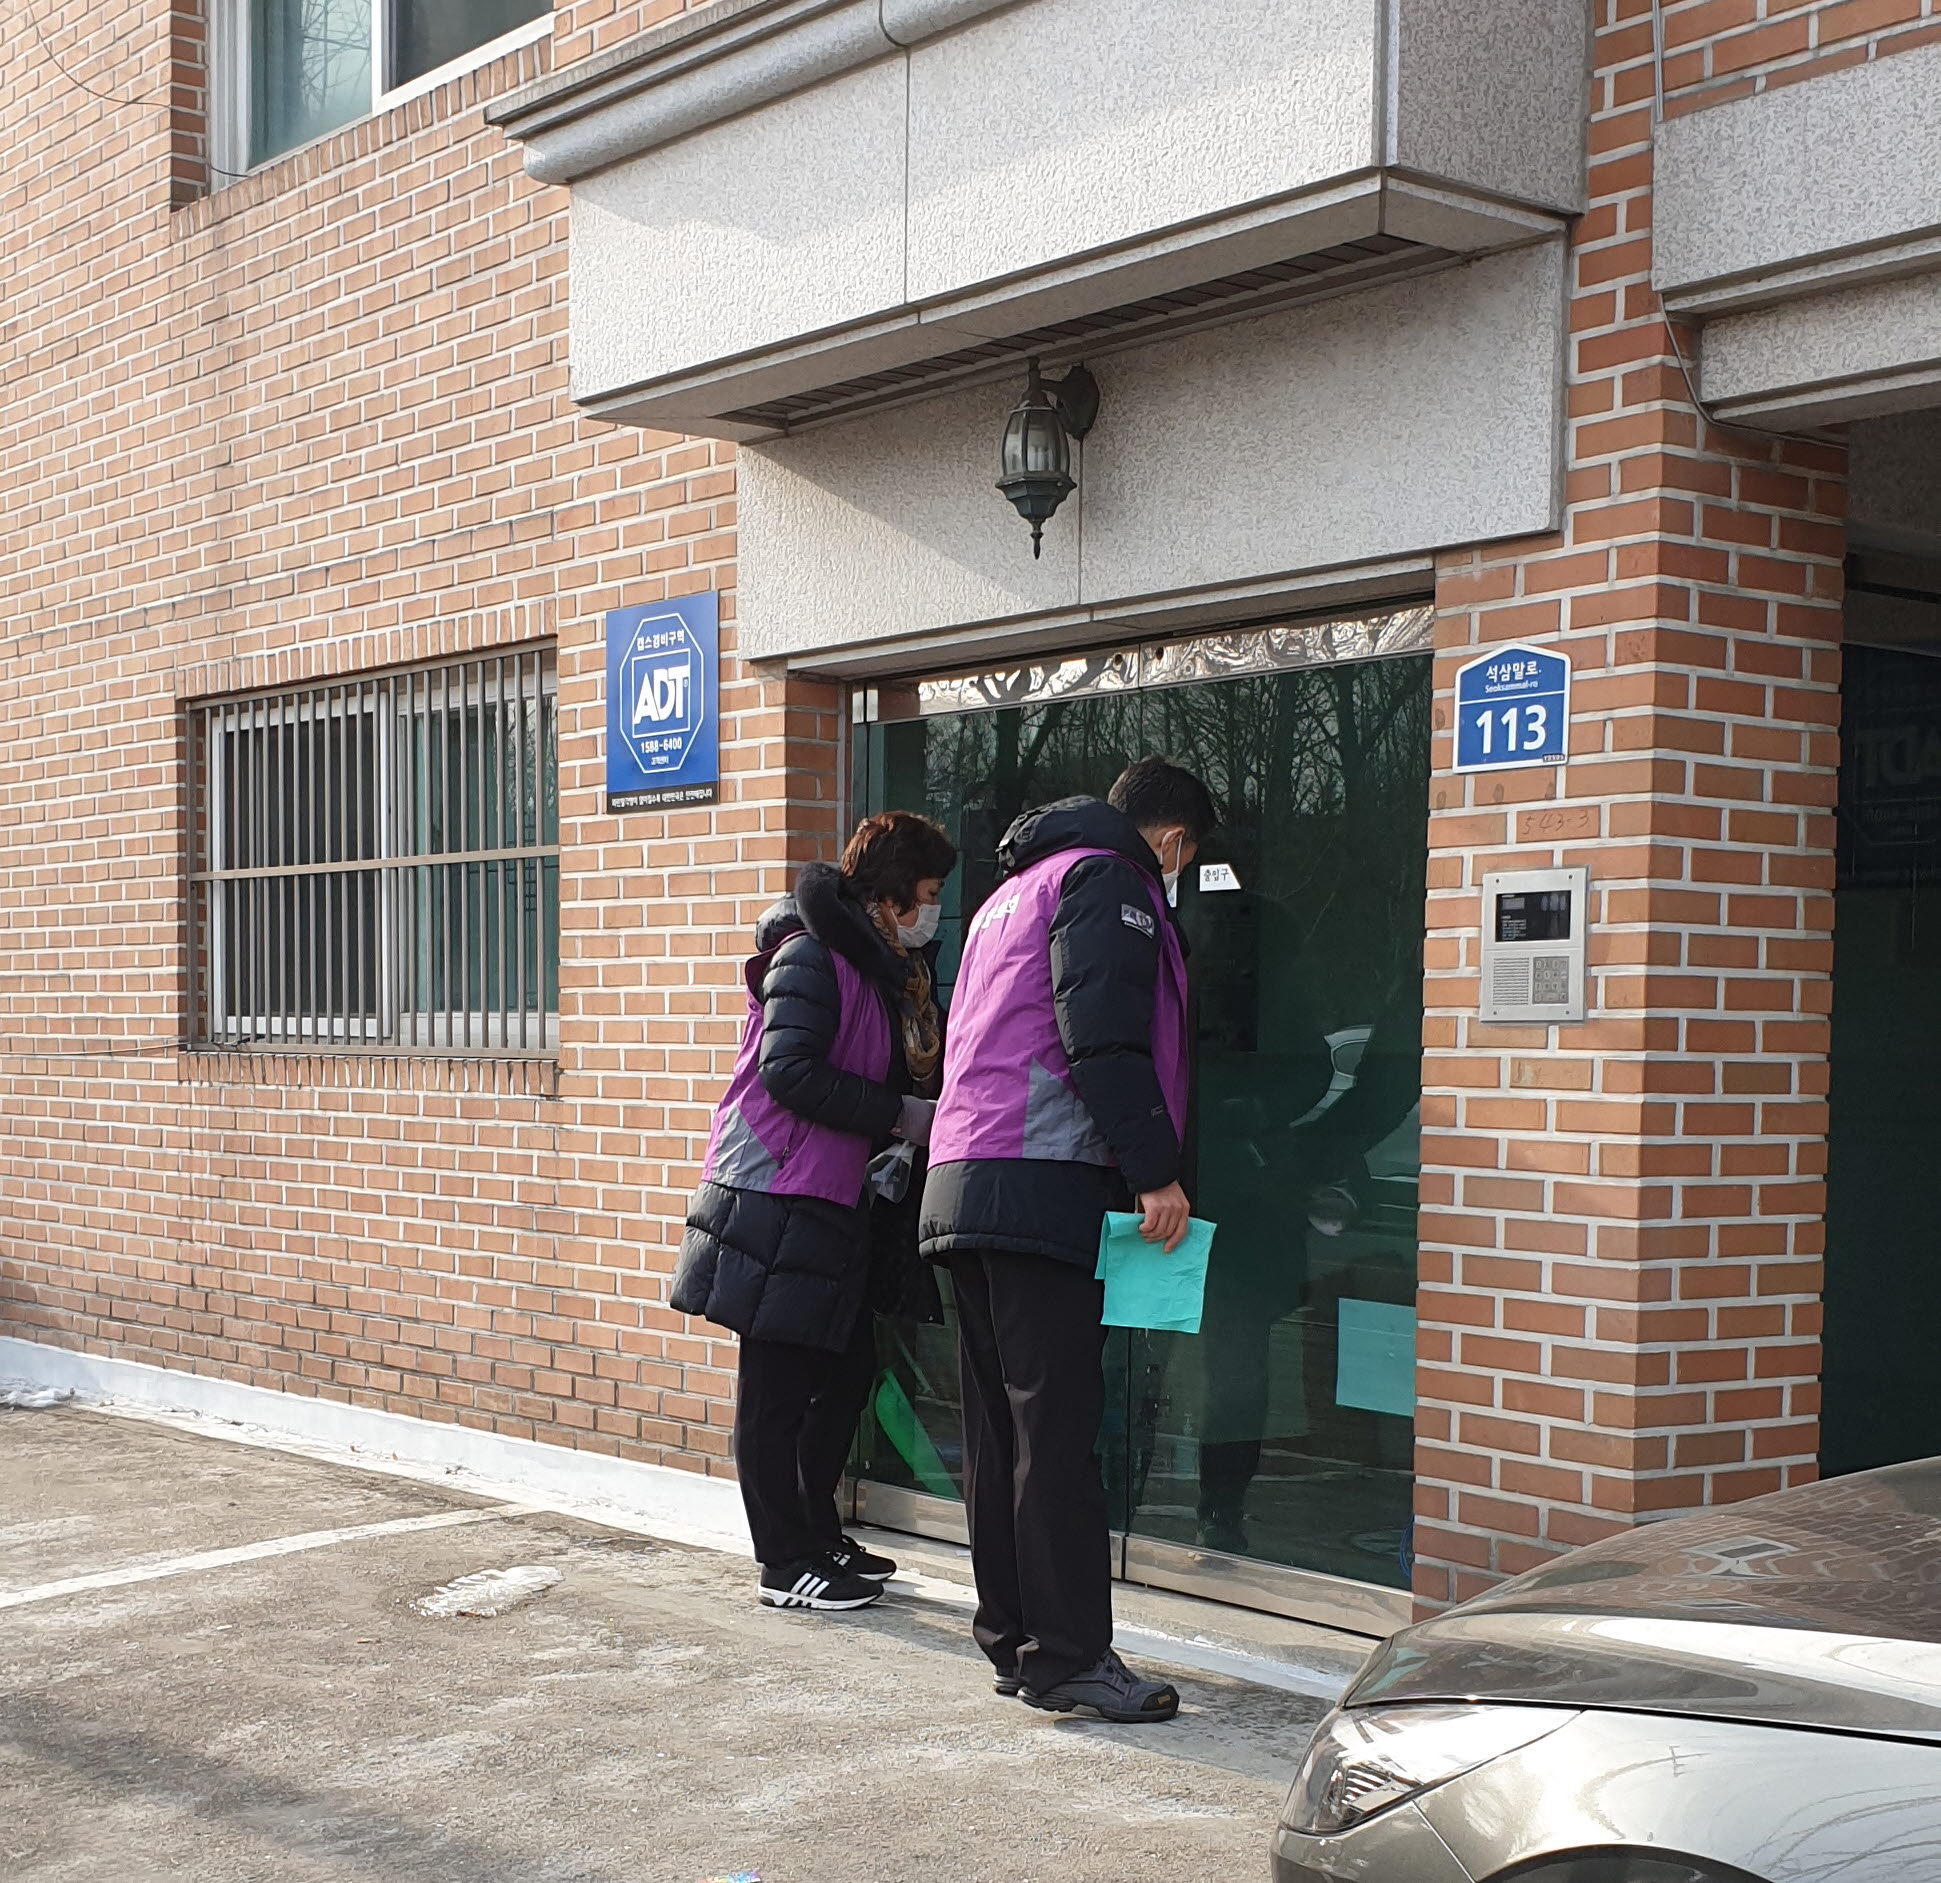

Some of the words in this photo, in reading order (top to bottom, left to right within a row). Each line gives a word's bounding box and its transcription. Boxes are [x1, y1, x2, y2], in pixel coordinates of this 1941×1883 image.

[1486, 661, 1539, 683] 석삼말로
[634, 665, 689, 724] ADT
[640, 737, 683, 753] 1588-6400
[1476, 704, 1547, 754] 113
